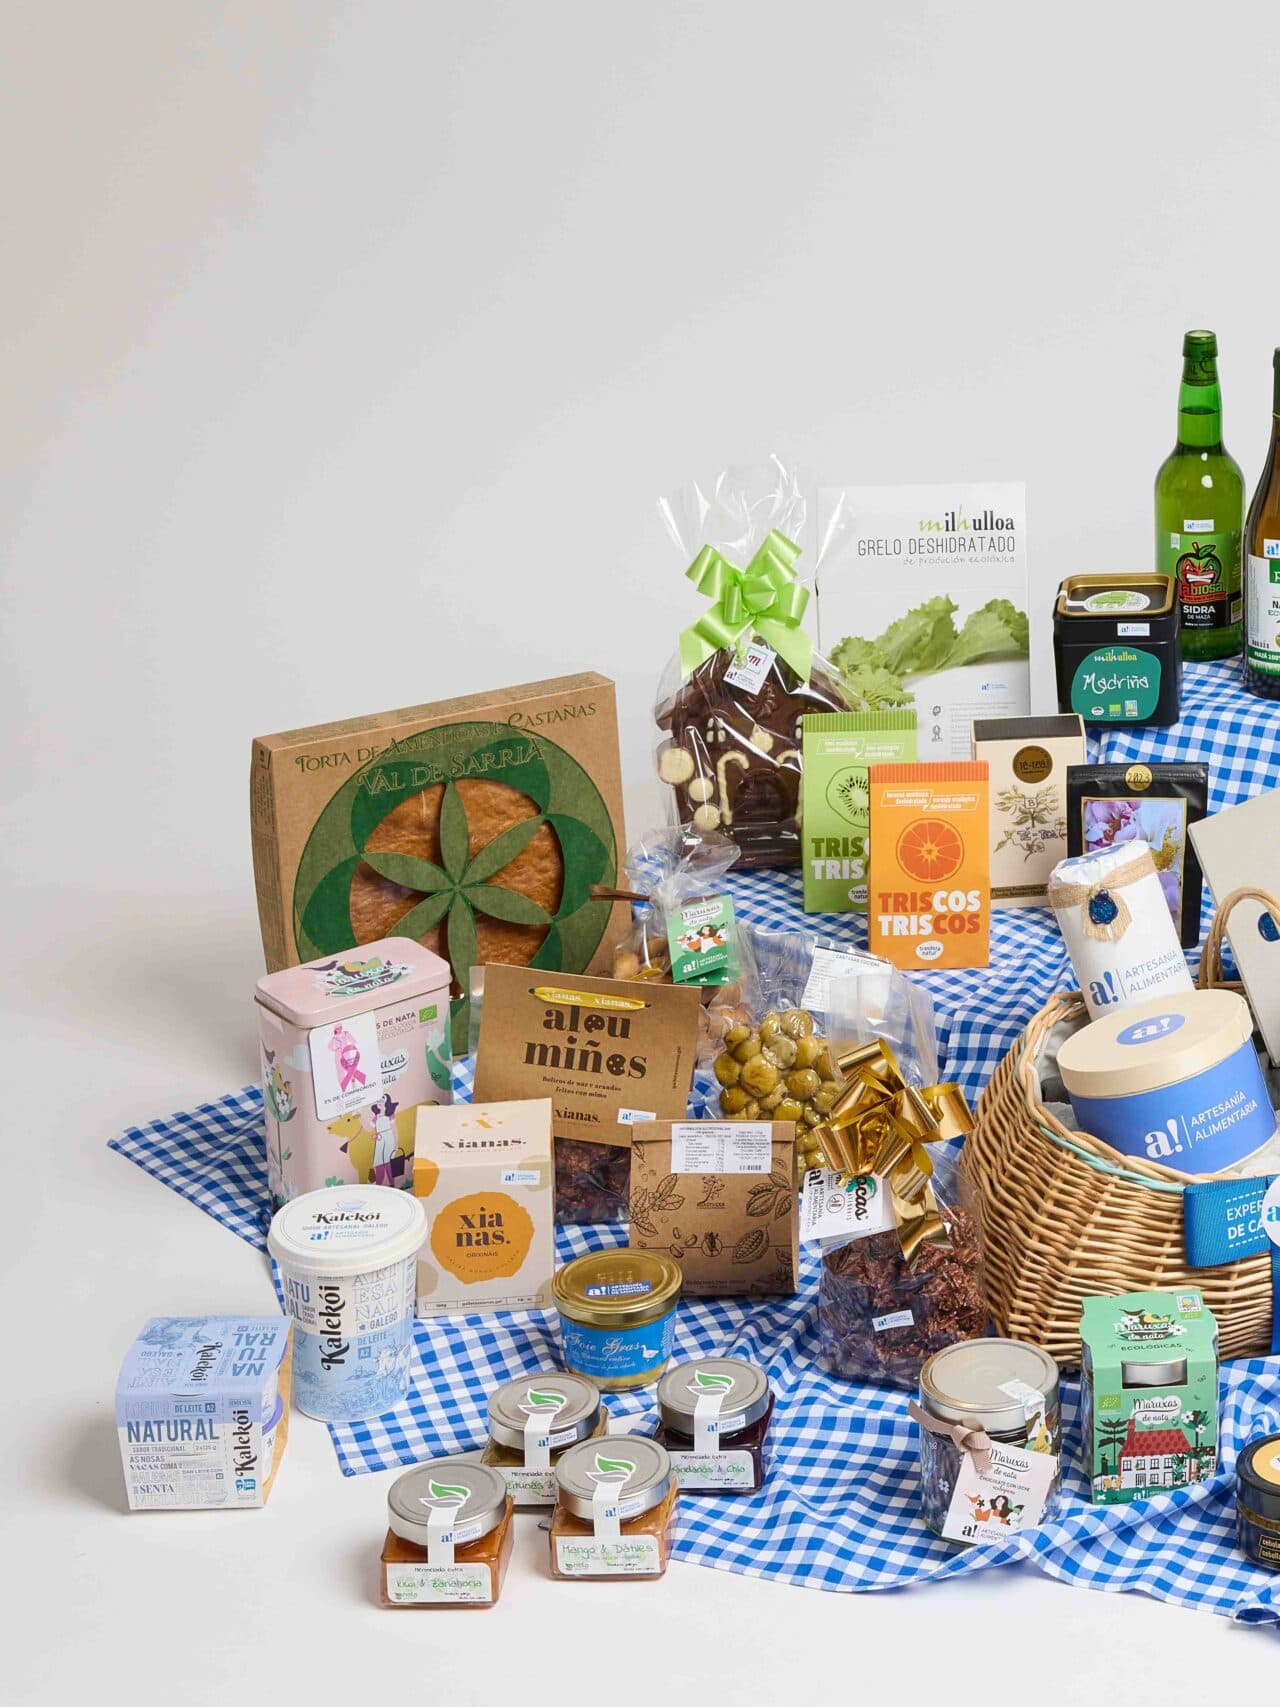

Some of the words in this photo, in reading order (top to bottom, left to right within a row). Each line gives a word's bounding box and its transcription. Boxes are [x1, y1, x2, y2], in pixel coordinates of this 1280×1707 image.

[858, 539, 901, 556] GRELO
[908, 536, 1015, 555] DESHIDRATADO
[1266, 543, 1280, 556] a!
[1183, 605, 1216, 614] SIDRA
[294, 752, 351, 772] TORTA
[357, 746, 380, 762] DE
[507, 702, 598, 729] CASTAÑAS
[357, 767, 406, 795] VAL
[410, 763, 445, 787] DE
[811, 859, 869, 880] TRIS
[878, 890, 981, 913] TRISCOS
[878, 914, 980, 937] TRISCOS
[683, 960, 697, 974] a!
[1089, 970, 1118, 1006] a!
[395, 1012, 417, 1024] NATA
[1131, 1017, 1170, 1041] a!
[554, 1106, 601, 1124] xianas.
[1144, 1118, 1184, 1160] a!
[1191, 1089, 1247, 1128] ARTESANÍA
[1195, 1099, 1258, 1142] ALIMENTARIA
[809, 1169, 825, 1187] a!
[458, 1206, 505, 1230] xia
[455, 1226, 512, 1248] nas.
[369, 1312, 398, 1330] GALEGO
[174, 1405, 184, 1414] DE
[184, 1404, 203, 1413] LEITE
[127, 1417, 220, 1443] NATURAL
[140, 1455, 165, 1463] NOSAS
[605, 1507, 617, 1518] a!
[441, 1532, 453, 1543] a!
[962, 1523, 978, 1538] a!
